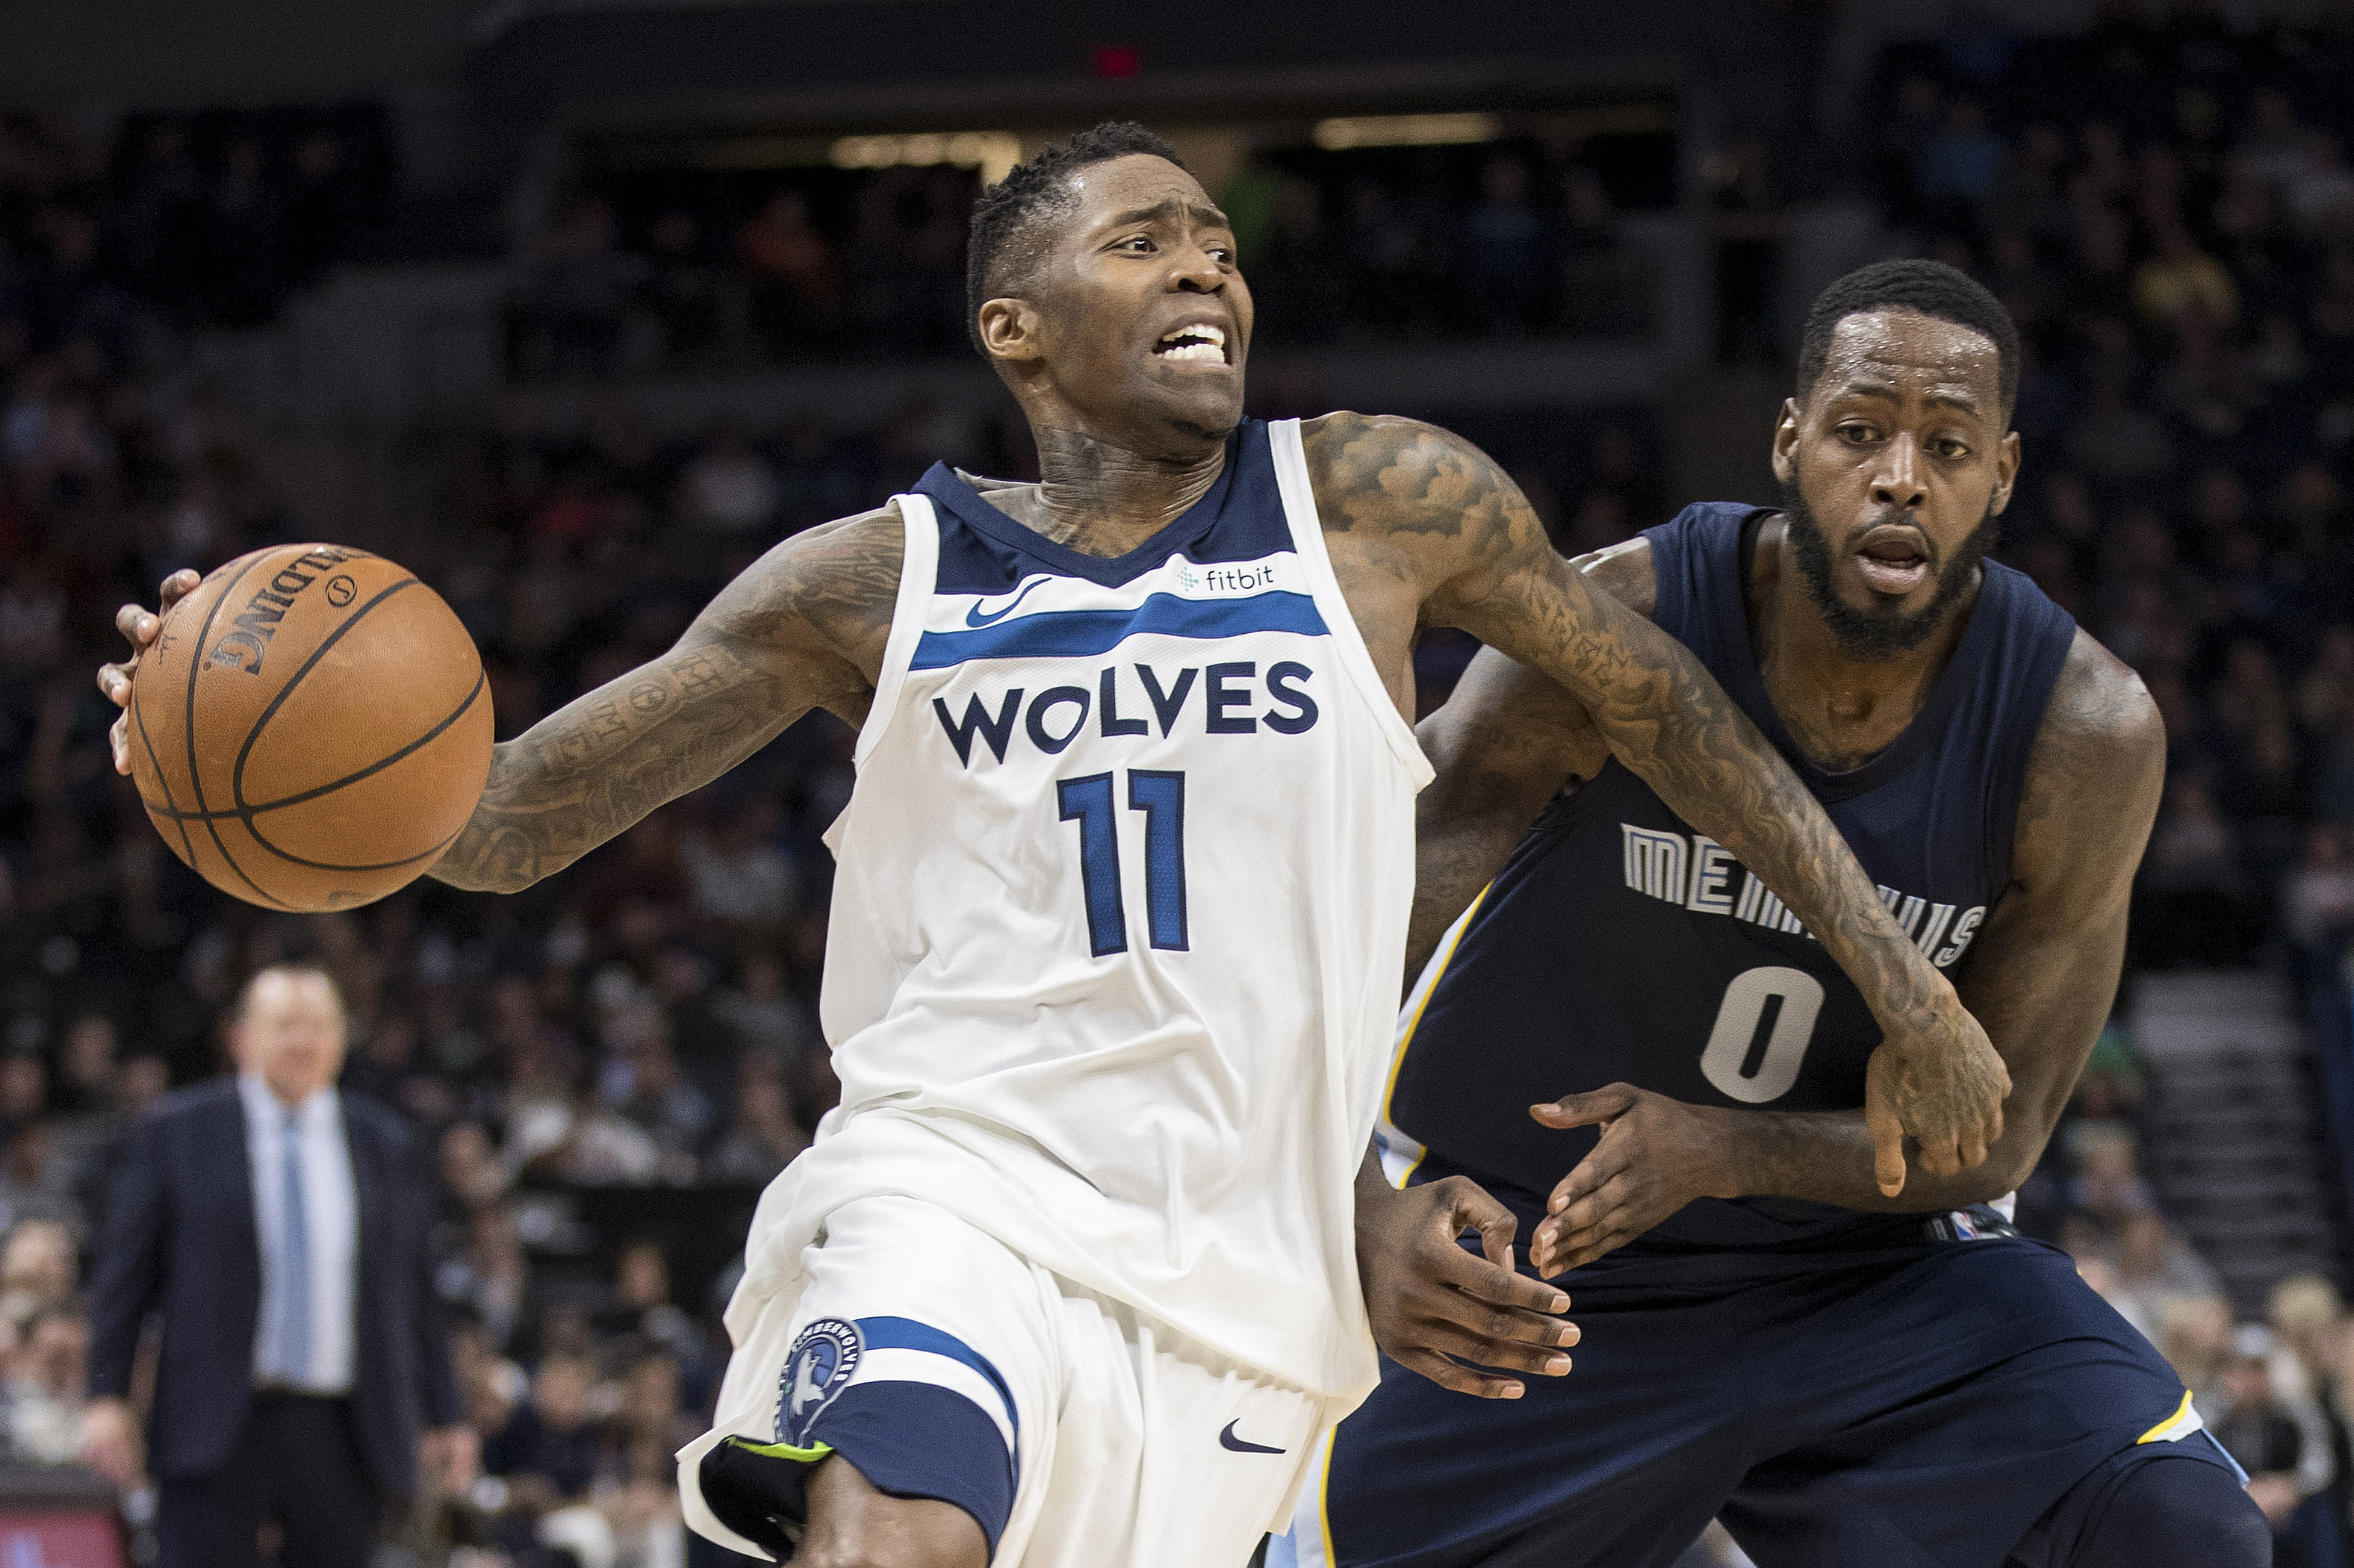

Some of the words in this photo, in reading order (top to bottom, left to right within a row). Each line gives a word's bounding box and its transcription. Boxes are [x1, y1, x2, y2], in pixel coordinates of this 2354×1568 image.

[1206, 566, 1273, 591] fitbit
[932, 660, 1319, 770] WOLVES
[1055, 768, 1190, 958] 11
[1700, 965, 1825, 1104] 0
